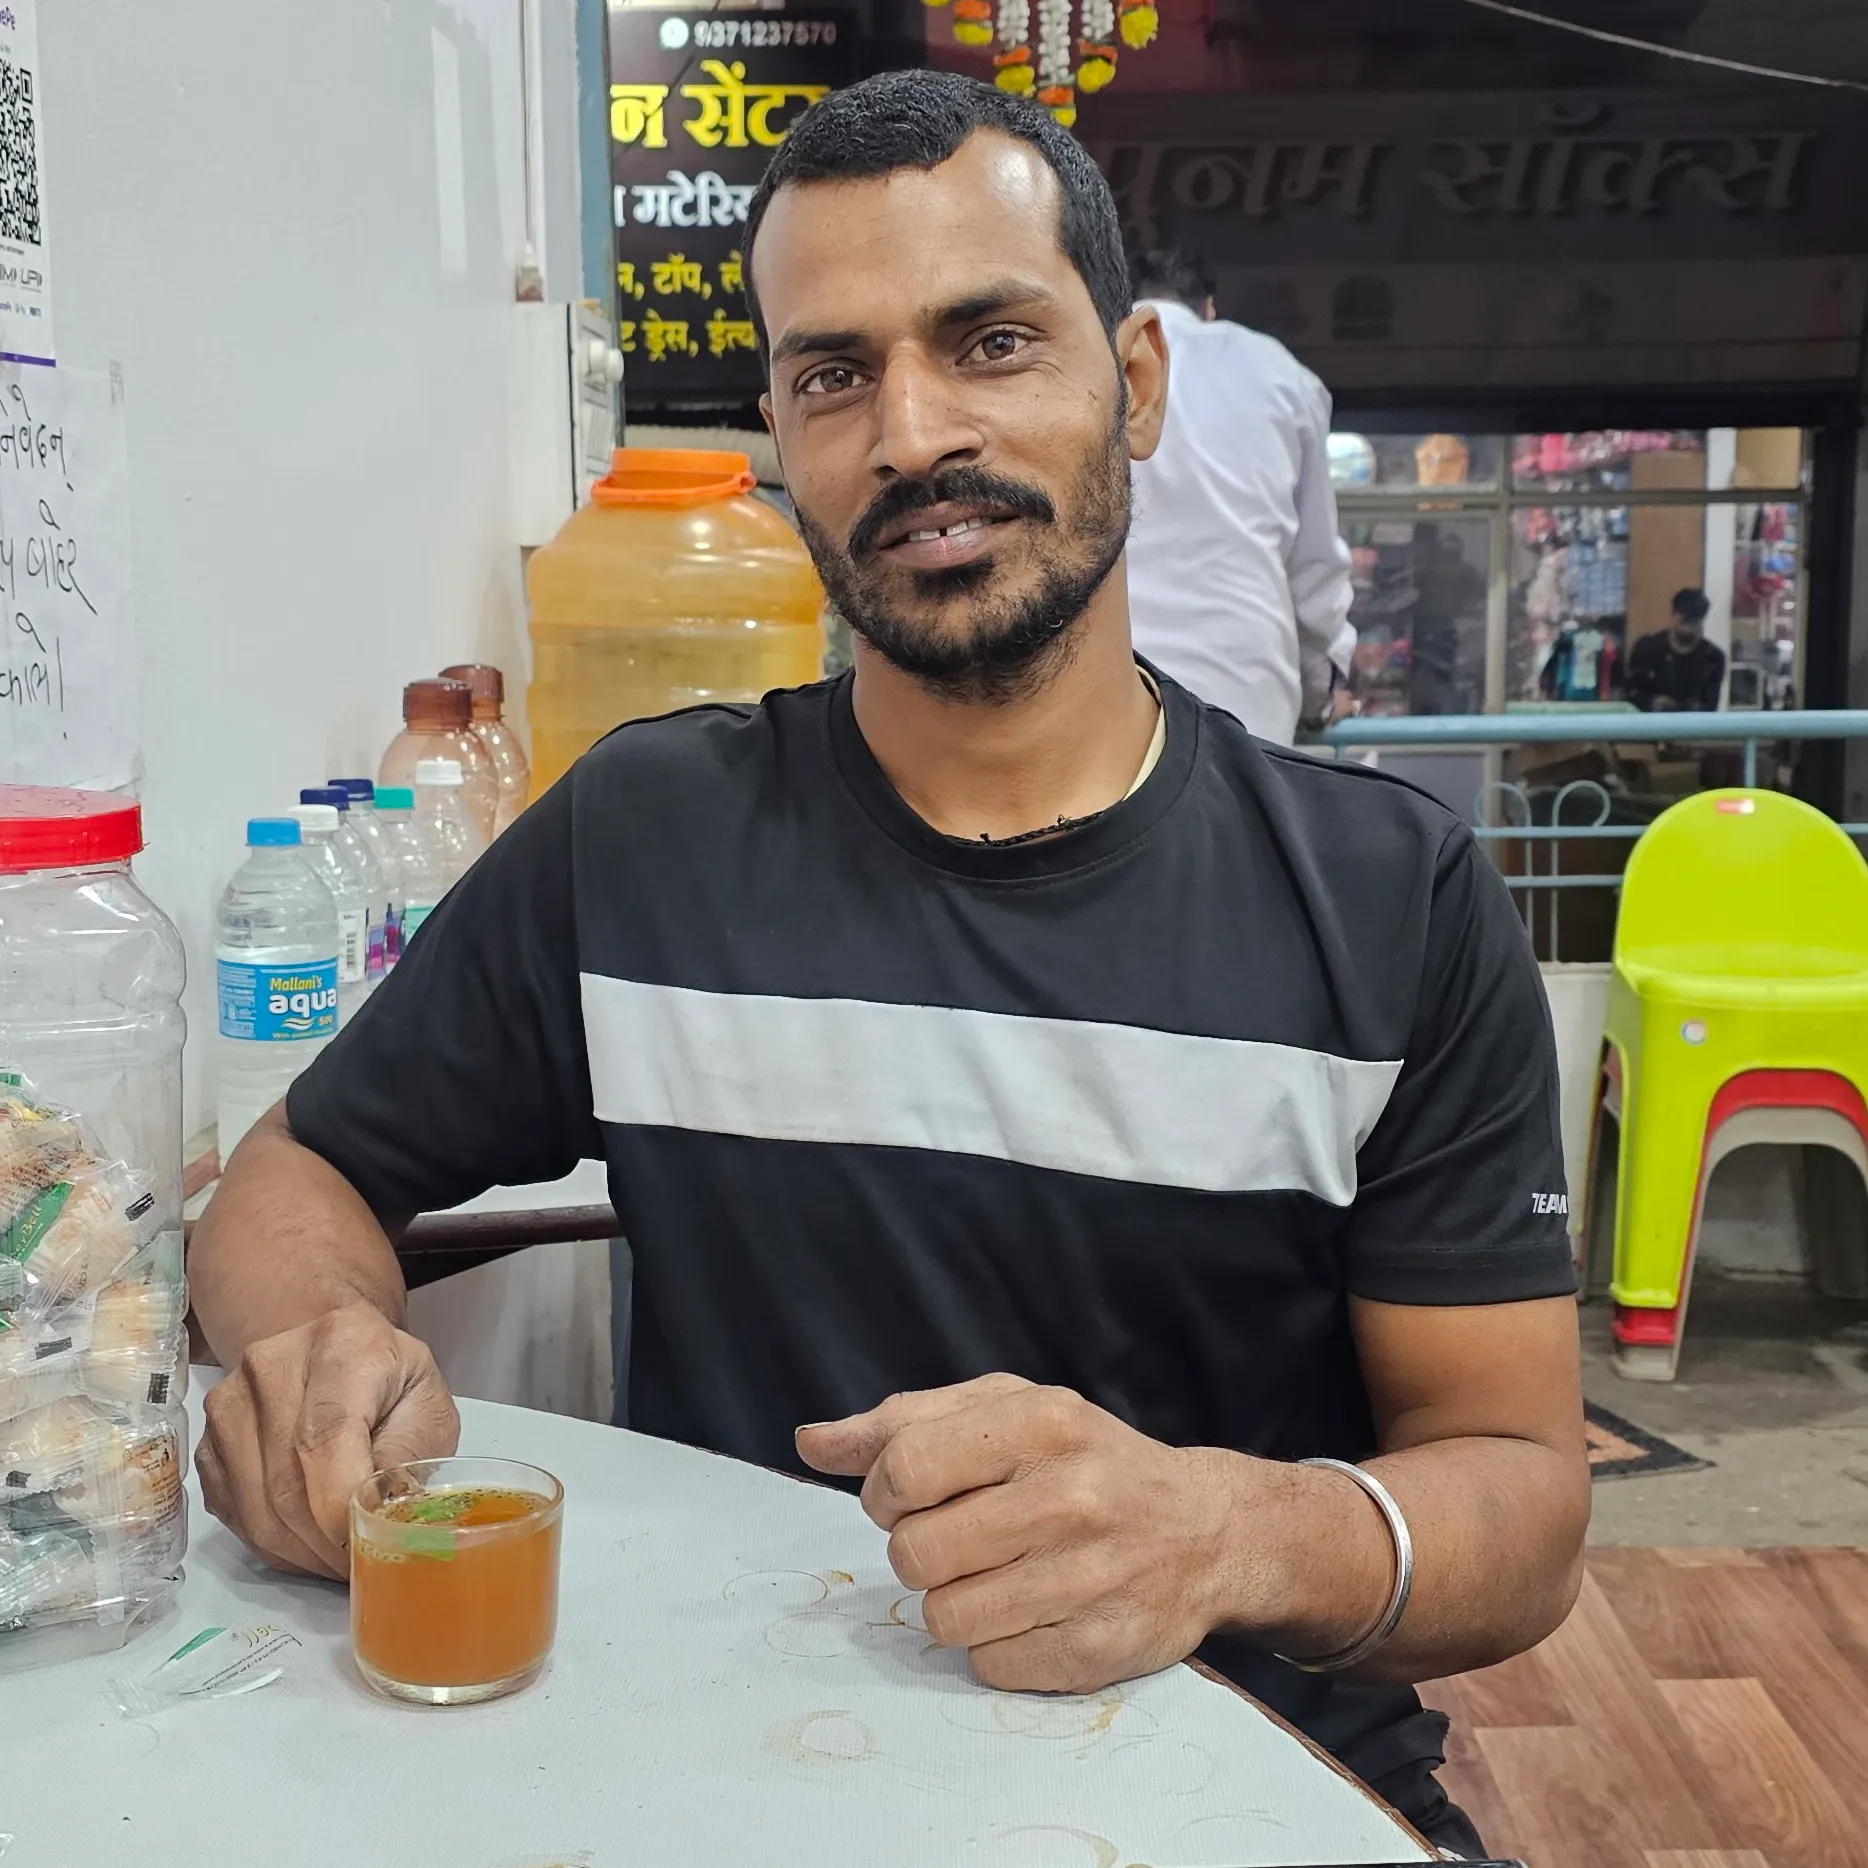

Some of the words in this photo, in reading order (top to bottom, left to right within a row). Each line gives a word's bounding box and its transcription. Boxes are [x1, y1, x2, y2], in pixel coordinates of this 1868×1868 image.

[610, 84, 669, 148] न
[680, 60, 830, 147] सेंट
[705, 308, 758, 359] ईत्य
[269, 988, 337, 1019] aqua
